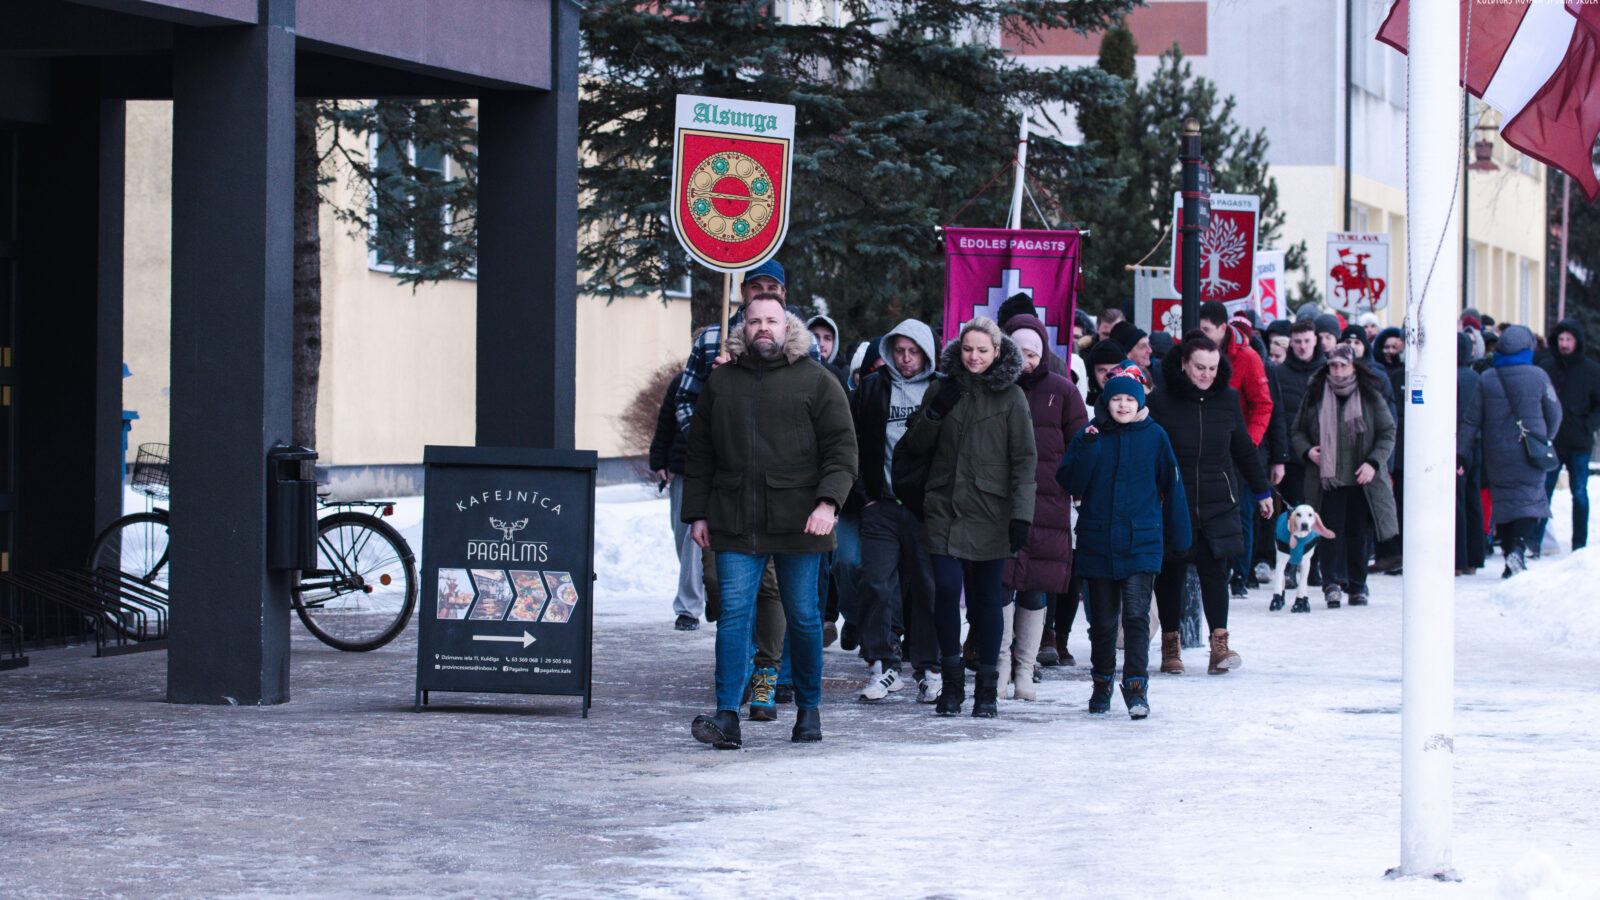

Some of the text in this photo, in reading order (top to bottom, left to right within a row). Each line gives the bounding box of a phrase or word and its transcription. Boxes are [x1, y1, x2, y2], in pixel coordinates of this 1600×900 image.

[692, 102, 777, 132] Alsunga
[1217, 199, 1252, 208] PAGASTS
[960, 237, 1066, 251] ĒDOLES PAGASTS
[456, 490, 561, 515] KAFEJNĪCA
[467, 542, 548, 562] PAGALMS
